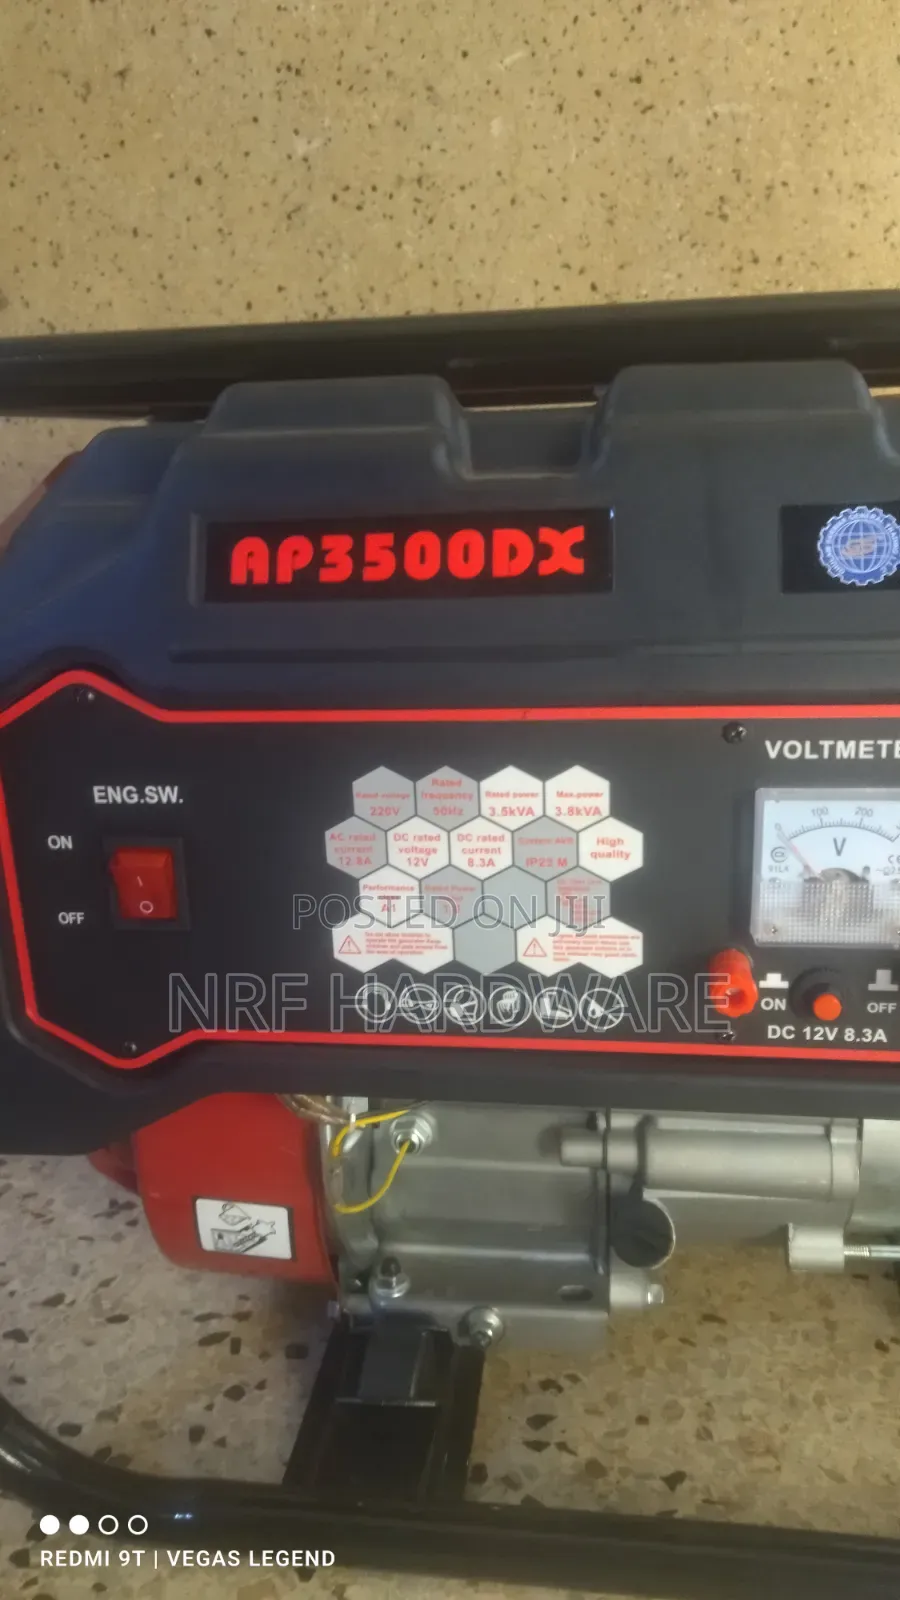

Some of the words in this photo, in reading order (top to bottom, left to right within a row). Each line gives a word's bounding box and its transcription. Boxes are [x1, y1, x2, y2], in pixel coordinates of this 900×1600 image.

[230, 524, 586, 586] AP3500DX
[431, 778, 462, 787] Rated
[93, 785, 184, 804] ENG.SW.
[370, 806, 400, 816] 220V
[488, 806, 535, 817] 3.5kVA
[555, 806, 603, 817] 3.8kVA
[47, 834, 73, 851] ON
[329, 833, 344, 841] AC
[393, 833, 408, 842] DC
[413, 833, 441, 842] rated
[457, 833, 472, 842] DC
[476, 833, 505, 843] rated
[596, 837, 624, 847] High
[398, 846, 438, 856] voltage
[461, 847, 502, 855] current
[833, 837, 847, 857] V
[590, 850, 632, 860] quality
[407, 857, 429, 867] 12V
[467, 857, 496, 868] 8.3A
[57, 911, 85, 925] OFF
[760, 997, 787, 1011] ON
[867, 1002, 897, 1014] OFF
[767, 1025, 795, 1040] DC
[803, 1026, 838, 1042] 12V
[844, 1027, 888, 1043] 8.3A
